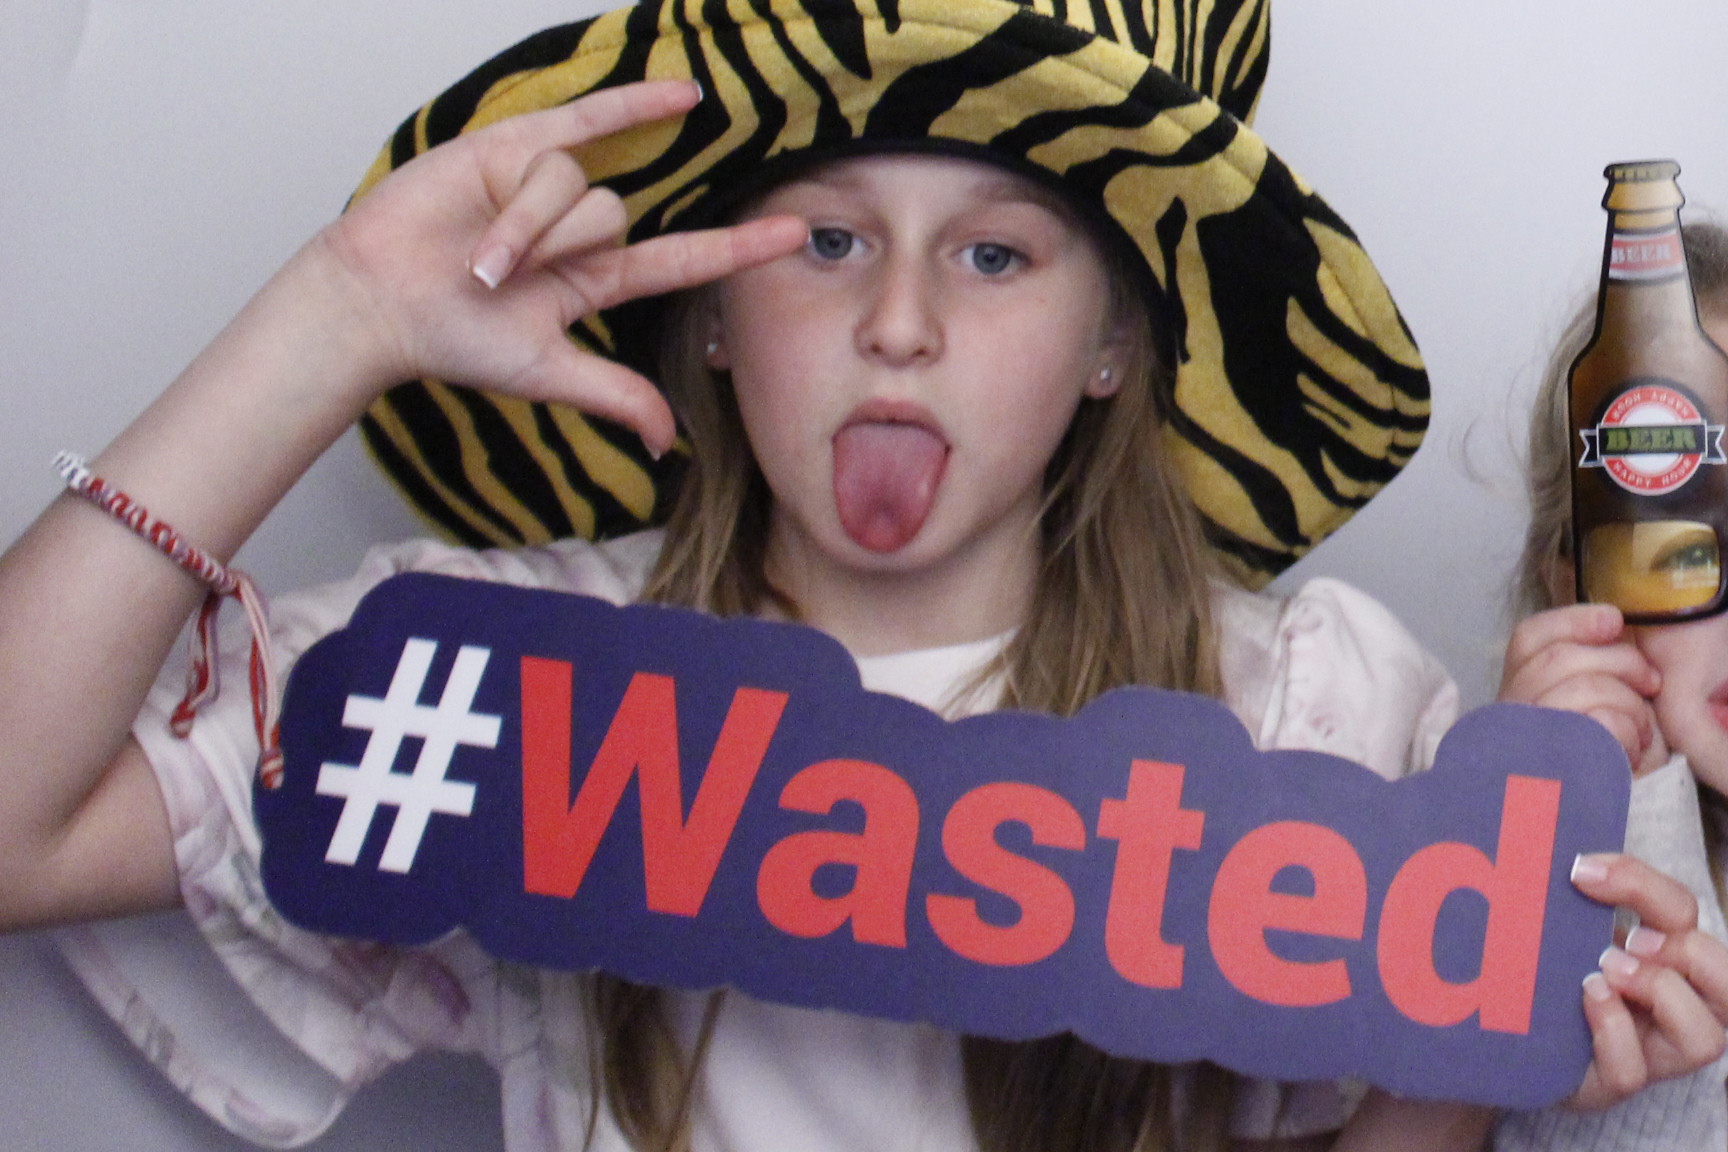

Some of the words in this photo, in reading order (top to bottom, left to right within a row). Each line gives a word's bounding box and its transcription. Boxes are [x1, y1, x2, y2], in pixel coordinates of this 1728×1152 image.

[1610, 242, 1671, 264] BEER
[1606, 426, 1697, 451] BEER
[315, 637, 1562, 1035] #Wasted
